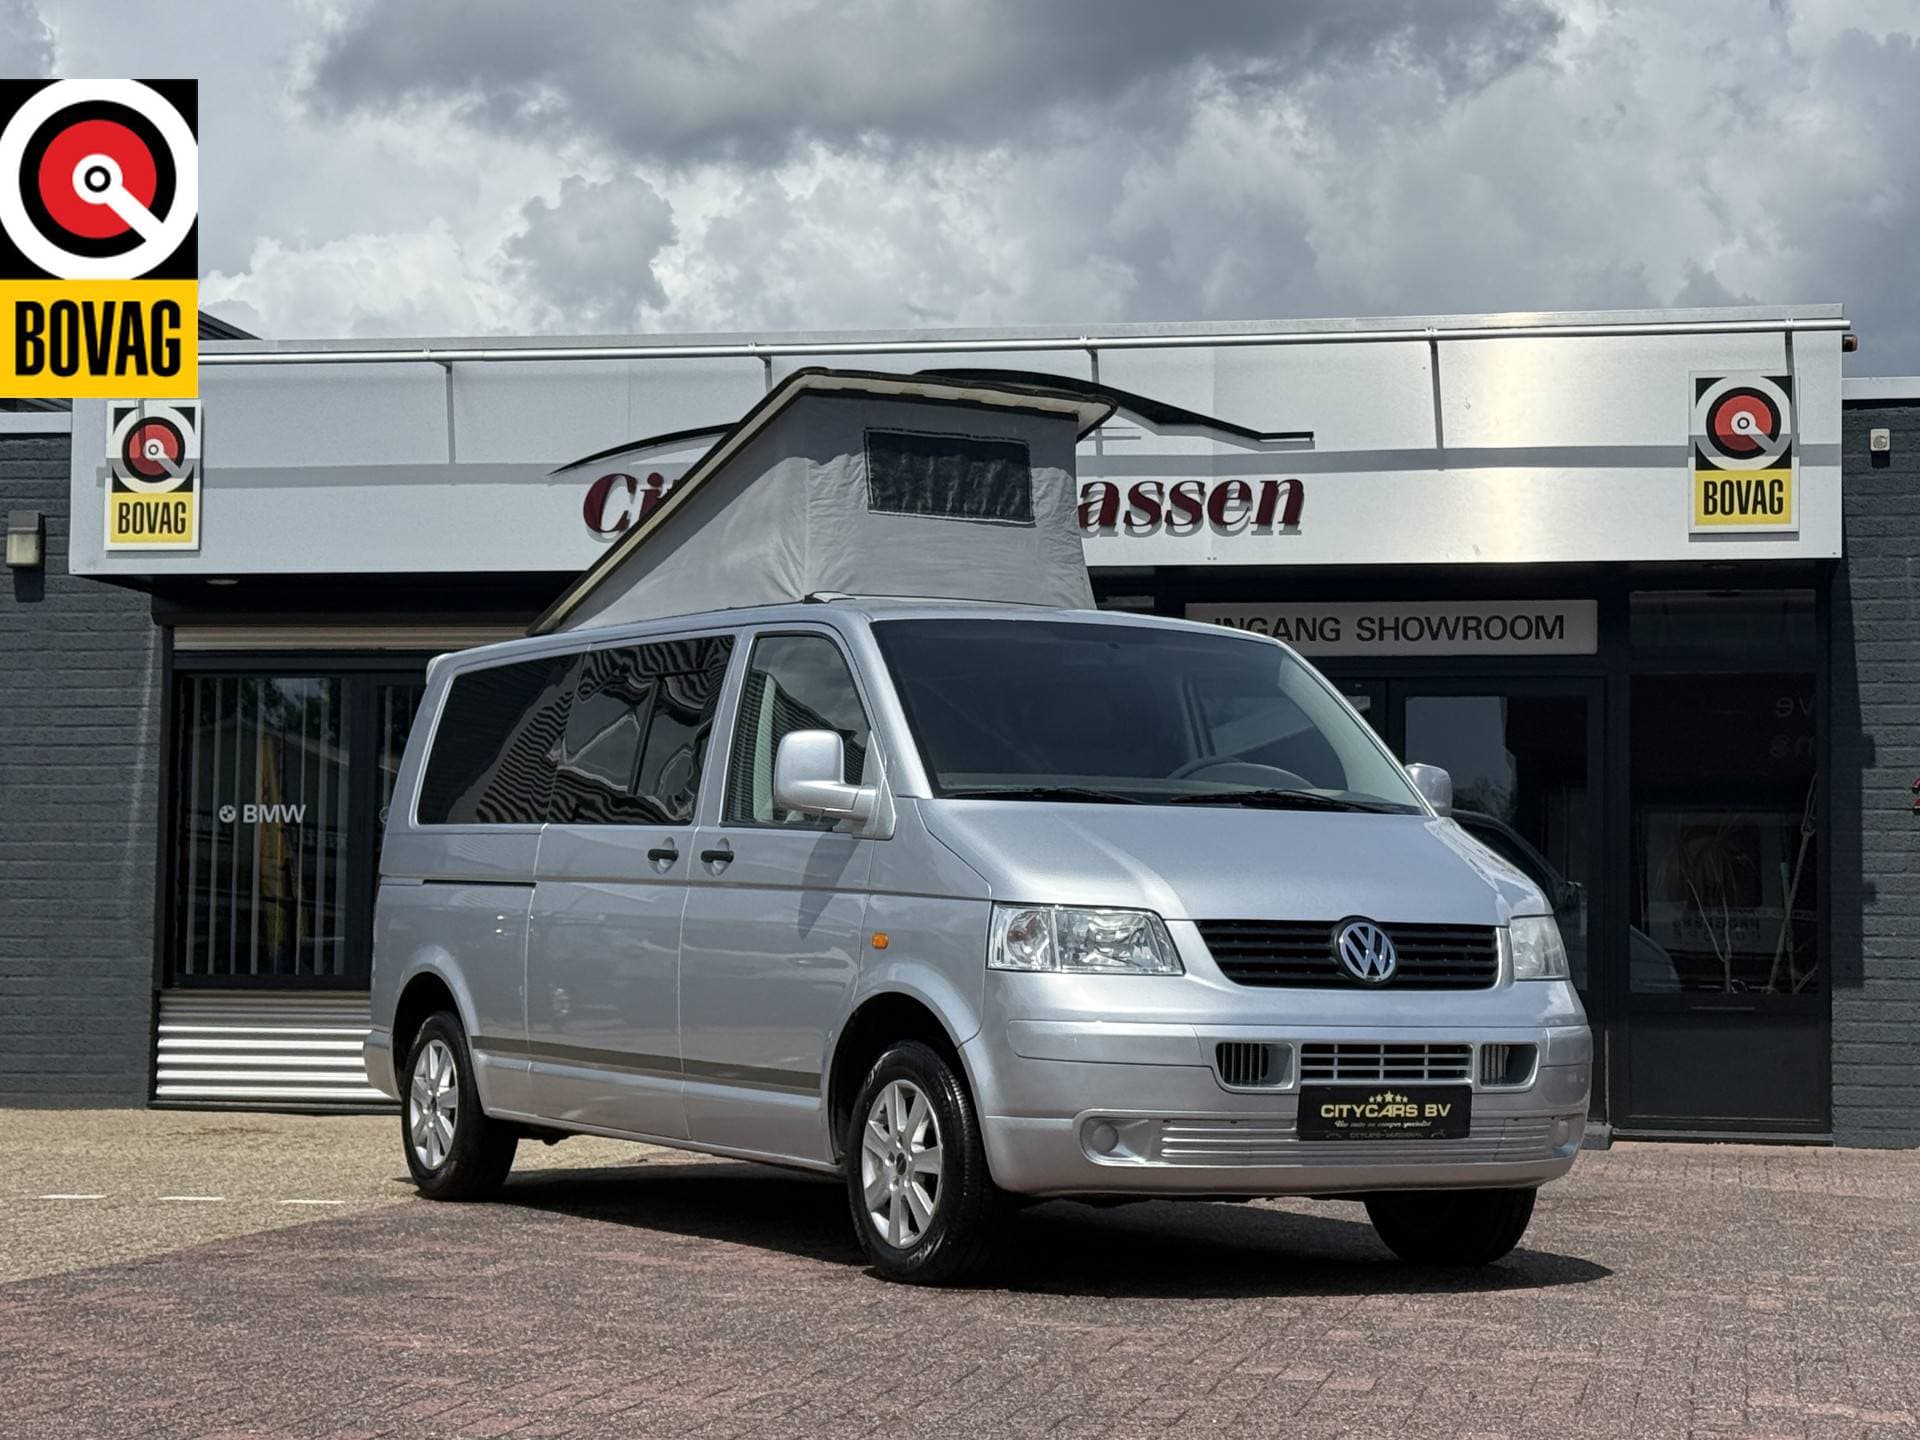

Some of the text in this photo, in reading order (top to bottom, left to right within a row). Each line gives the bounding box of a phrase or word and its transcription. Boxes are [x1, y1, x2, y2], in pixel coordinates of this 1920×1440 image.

[583, 472, 680, 533] Ci
[1703, 479, 1784, 516] BOVAG
[117, 501, 187, 535] BOVAG
[1356, 615, 1565, 642] SHOWROOM
[242, 804, 307, 824] BMW
[1320, 1103, 1452, 1118] CITYCARS BV
